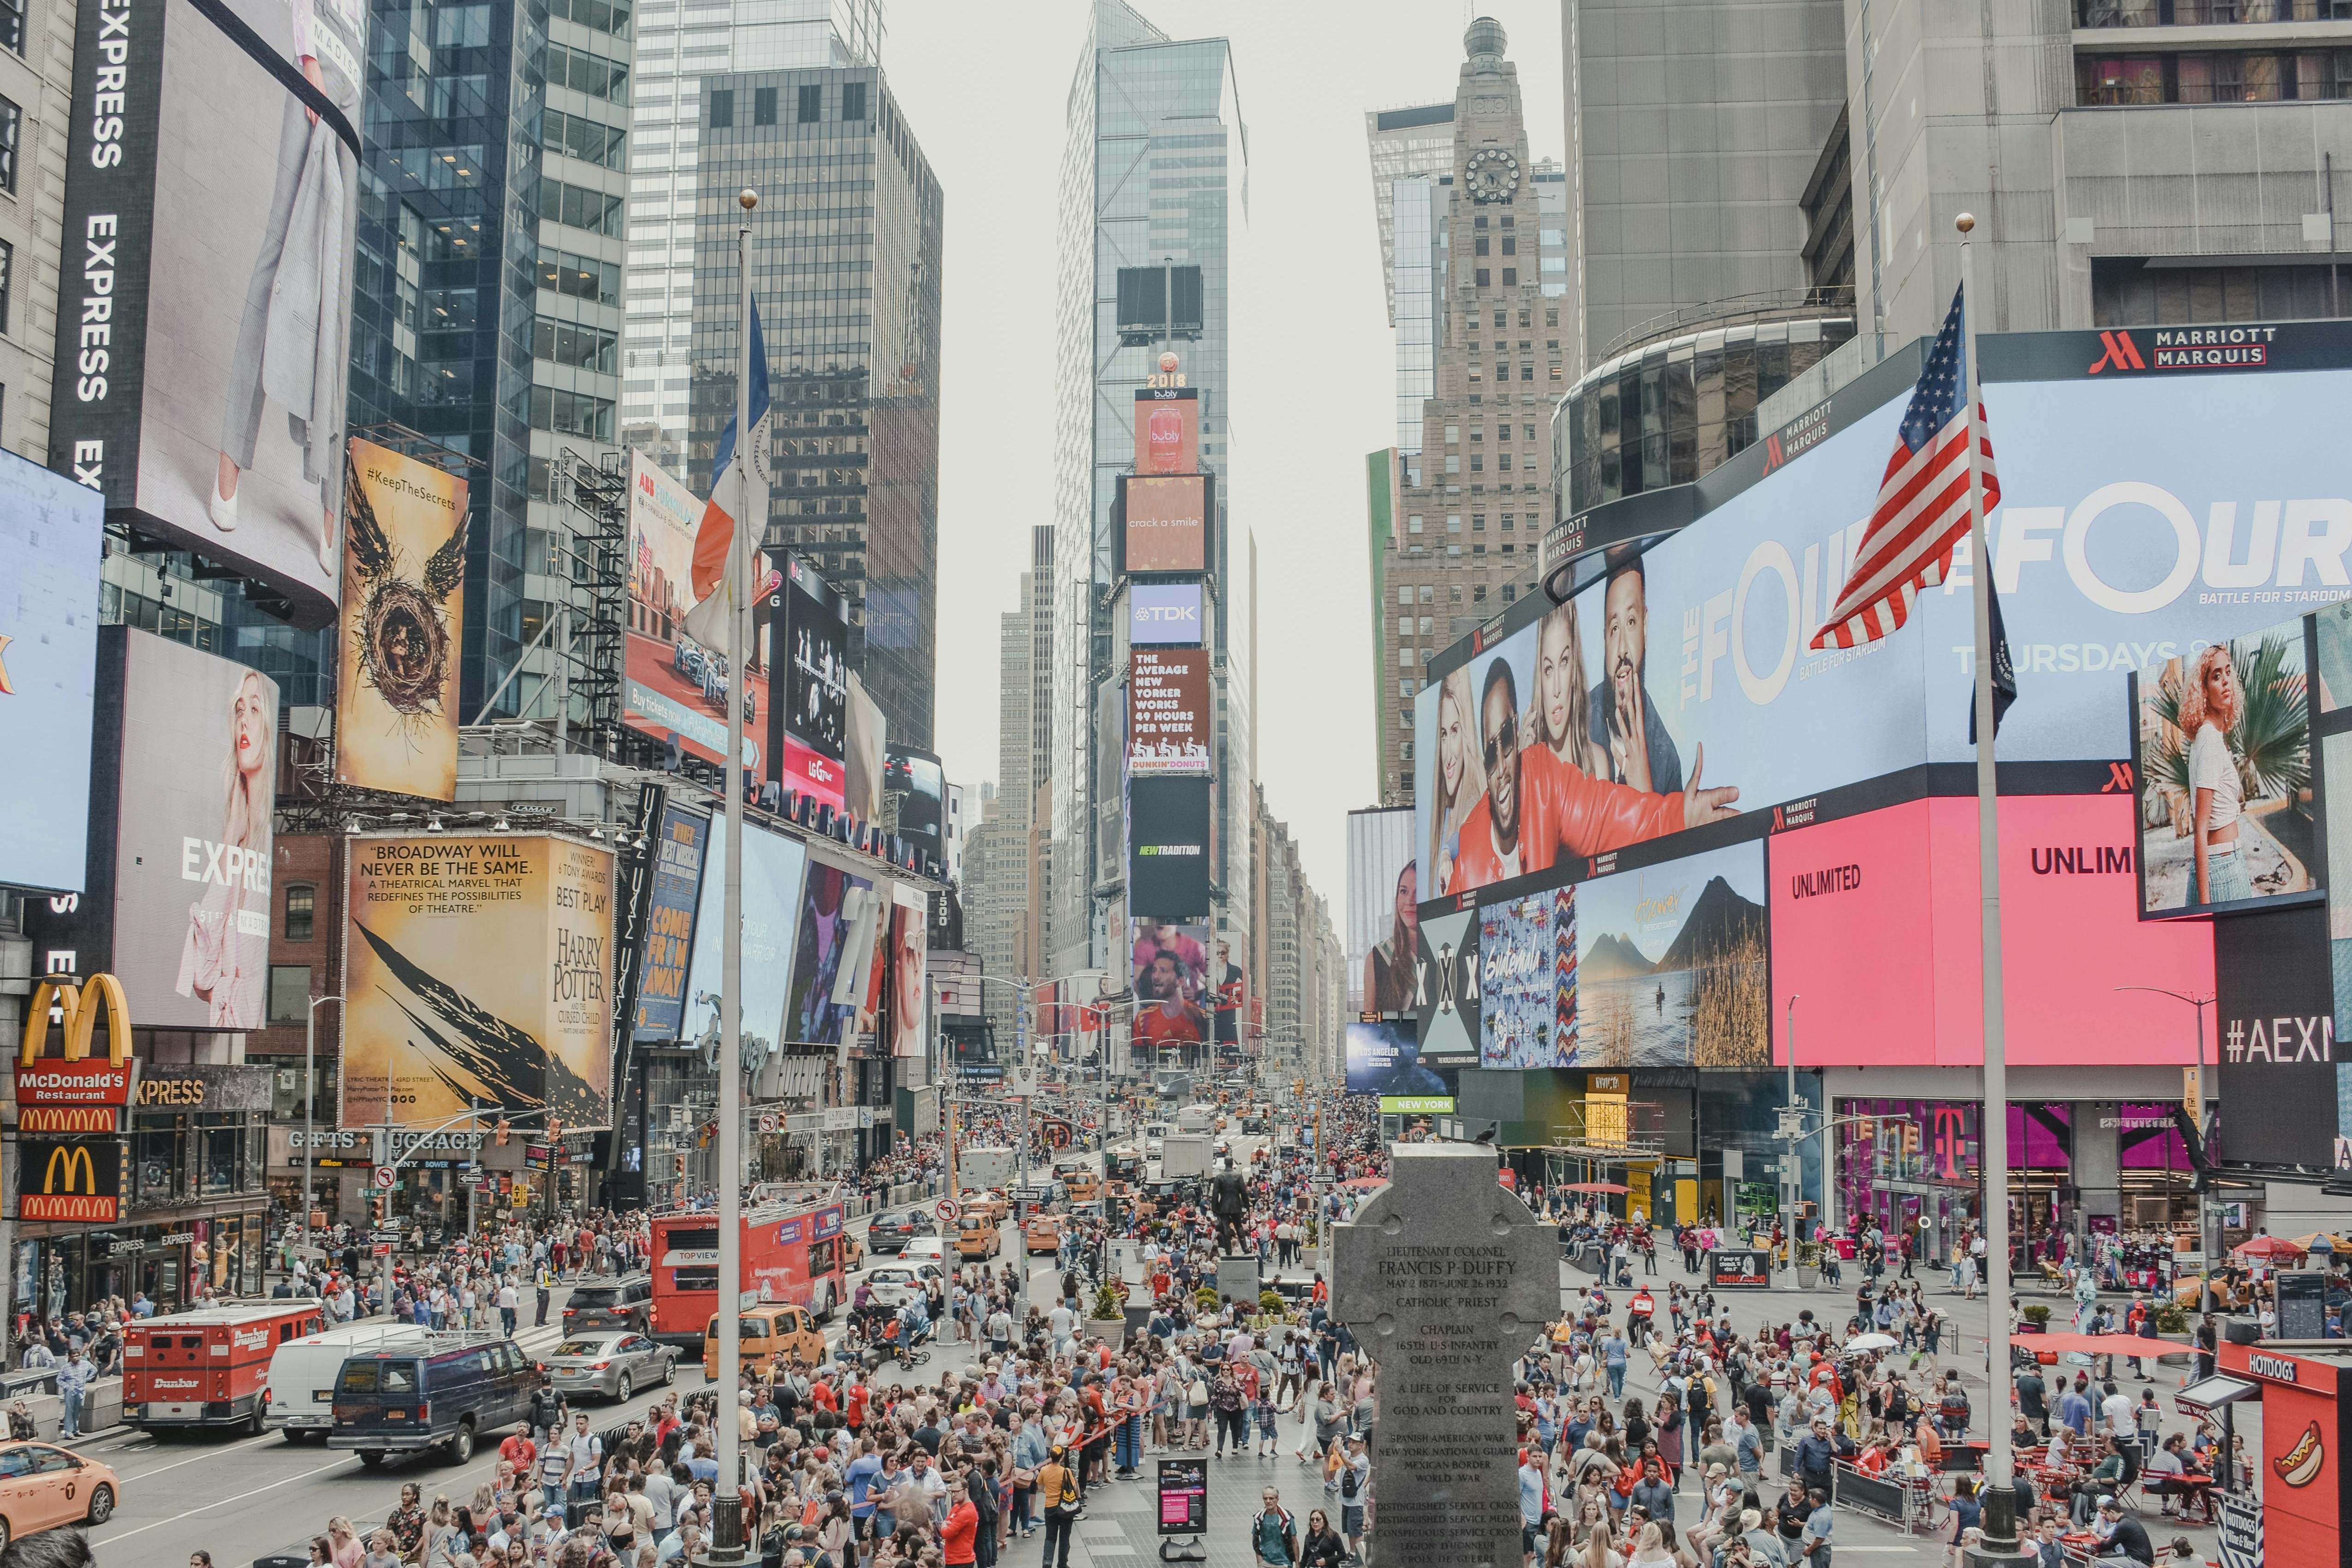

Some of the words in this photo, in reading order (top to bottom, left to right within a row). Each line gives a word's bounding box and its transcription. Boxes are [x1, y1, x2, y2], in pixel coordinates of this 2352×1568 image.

[77, 214, 118, 403] EXPRESS
[2155, 327, 2276, 346] MARRIOTT
[2157, 348, 2263, 366] MARQUIS
[1146, 374, 1187, 388] 2018
[1154, 389, 1178, 399] bubly
[1785, 400, 1832, 439] MARRIOTT
[1152, 430, 1180, 443] bubly
[1785, 422, 1827, 458] MARQUIS
[367, 467, 457, 511] #KeepTheSecrets
[639, 472, 654, 497] ABB
[1128, 517, 1158, 527] crack
[1546, 515, 1588, 547] MARRIOTT
[1547, 535, 1581, 564] MARQUIS
[1996, 481, 2352, 614] FOUR
[796, 569, 803, 582] LG
[2198, 592, 2251, 605] BATTLE
[2253, 591, 2281, 603] FOR
[2283, 589, 2351, 603] STARDOM
[1149, 606, 1196, 621] TDK
[1481, 614, 1505, 639] MARRIOTT
[1482, 628, 1503, 647] MARQUIS
[1135, 654, 1158, 664] THE
[1680, 605, 1701, 711] THE
[1800, 657, 1827, 682] BATTLE
[1829, 651, 1845, 670] FOR
[1846, 636, 1887, 663] STARDOM
[1952, 641, 2180, 675] TURSDAYS
[1135, 665, 1188, 675] AVERAGE
[1135, 677, 1162, 687] NEW
[1135, 689, 1181, 698] YORKER
[632, 687, 645, 711] Buy
[647, 696, 668, 719] tickets
[668, 709, 681, 725] now
[1135, 700, 1178, 710] WORKS
[1135, 712, 1151, 721] 49
[1154, 711, 1194, 721] HOURS
[1135, 723, 1157, 733] PER
[1159, 723, 1193, 732] WEEK
[1786, 797, 1817, 815] MARRIOTT
[1786, 812, 1814, 826] MARQUIS
[370, 845, 474, 859] “BROADWAY
[479, 844, 521, 858] WILL
[661, 838, 677, 863] BEST
[676, 843, 699, 870] MUSICAL
[1597, 852, 1617, 865] MARRIOTT
[1597, 861, 1616, 873] MARQUIS
[2031, 846, 2136, 874] UNLIM
[361, 863, 414, 876] NEVER
[420, 862, 440, 875] BE
[445, 862, 478, 875] THE
[483, 861, 533, 874] SAME.
[564, 863, 580, 877] TONY
[581, 868, 606, 884] AWARDS
[369, 880, 376, 889] A
[380, 879, 445, 889] THEATRICAL
[449, 879, 490, 888] MARVEL
[494, 878, 523, 887] THAT
[1792, 864, 1861, 899] UNLIMITED
[368, 892, 423, 901] REDEFINES
[427, 892, 448, 901] THE
[451, 891, 521, 900] POSSIBILITIES
[557, 886, 580, 909] BEST
[583, 891, 606, 914] PLAY
[409, 905, 423, 914] OF
[427, 904, 481, 913] THEATRE.”
[653, 904, 692, 936] COME
[747, 920, 767, 943] YOUR
[557, 927, 604, 969] HARRY
[1485, 932, 1540, 981] Guatemala
[553, 963, 606, 1003] POTTER
[642, 966, 684, 998] AWAY
[558, 1011, 581, 1025] CURSED
[582, 1012, 600, 1025] CHILD
[1360, 1047, 1372, 1057] LOS
[20, 1073, 124, 1090] McDonald's
[36, 1091, 105, 1100] Restaurant
[134, 1080, 204, 1105] XPRESS
[836, 1110, 845, 1121] POLO
[288, 1131, 355, 1148] GFTS
[110, 1239, 144, 1253] EXPRESS
[162, 1232, 194, 1246] EXPRESS
[1387, 1247, 1451, 1257] LIEUTENANT
[1454, 1246, 1506, 1257] COLONEL
[1378, 1261, 1443, 1275] FRANCIS
[1463, 1261, 1517, 1275] DUFFY
[1386, 1279, 1407, 1288] MAY
[1486, 1279, 1508, 1288] 1932
[1396, 1297, 1452, 1307] CATHOLIC
[1458, 1297, 1498, 1307] PRIEST
[234, 1328, 269, 1347] Dunbar
[1420, 1325, 1474, 1335] CHAPLAIN
[1410, 1355, 1431, 1364] OLD
[2249, 1354, 2294, 1382] HOTDOGS
[154, 1378, 199, 1389] Dunbar
[1410, 1384, 1432, 1393] LIFE
[1436, 1384, 1450, 1393] OF
[1455, 1384, 1500, 1393] SERVICE
[1393, 1407, 1420, 1415] GOD
[1422, 1407, 1447, 1415] AND
[1450, 1406, 1503, 1415] COUNTRY
[2176, 1401, 2191, 1415] HOT
[1431, 1434, 1481, 1443] AMERICAN
[1405, 1461, 1449, 1470] MEXICAN
[1453, 1461, 1491, 1469] BORDER
[2227, 1511, 2255, 1534] HOTDOGS
[2226, 1529, 2239, 1545] Wine
[2239, 1535, 2244, 1546] &
[2243, 1536, 2255, 1551] Beer
